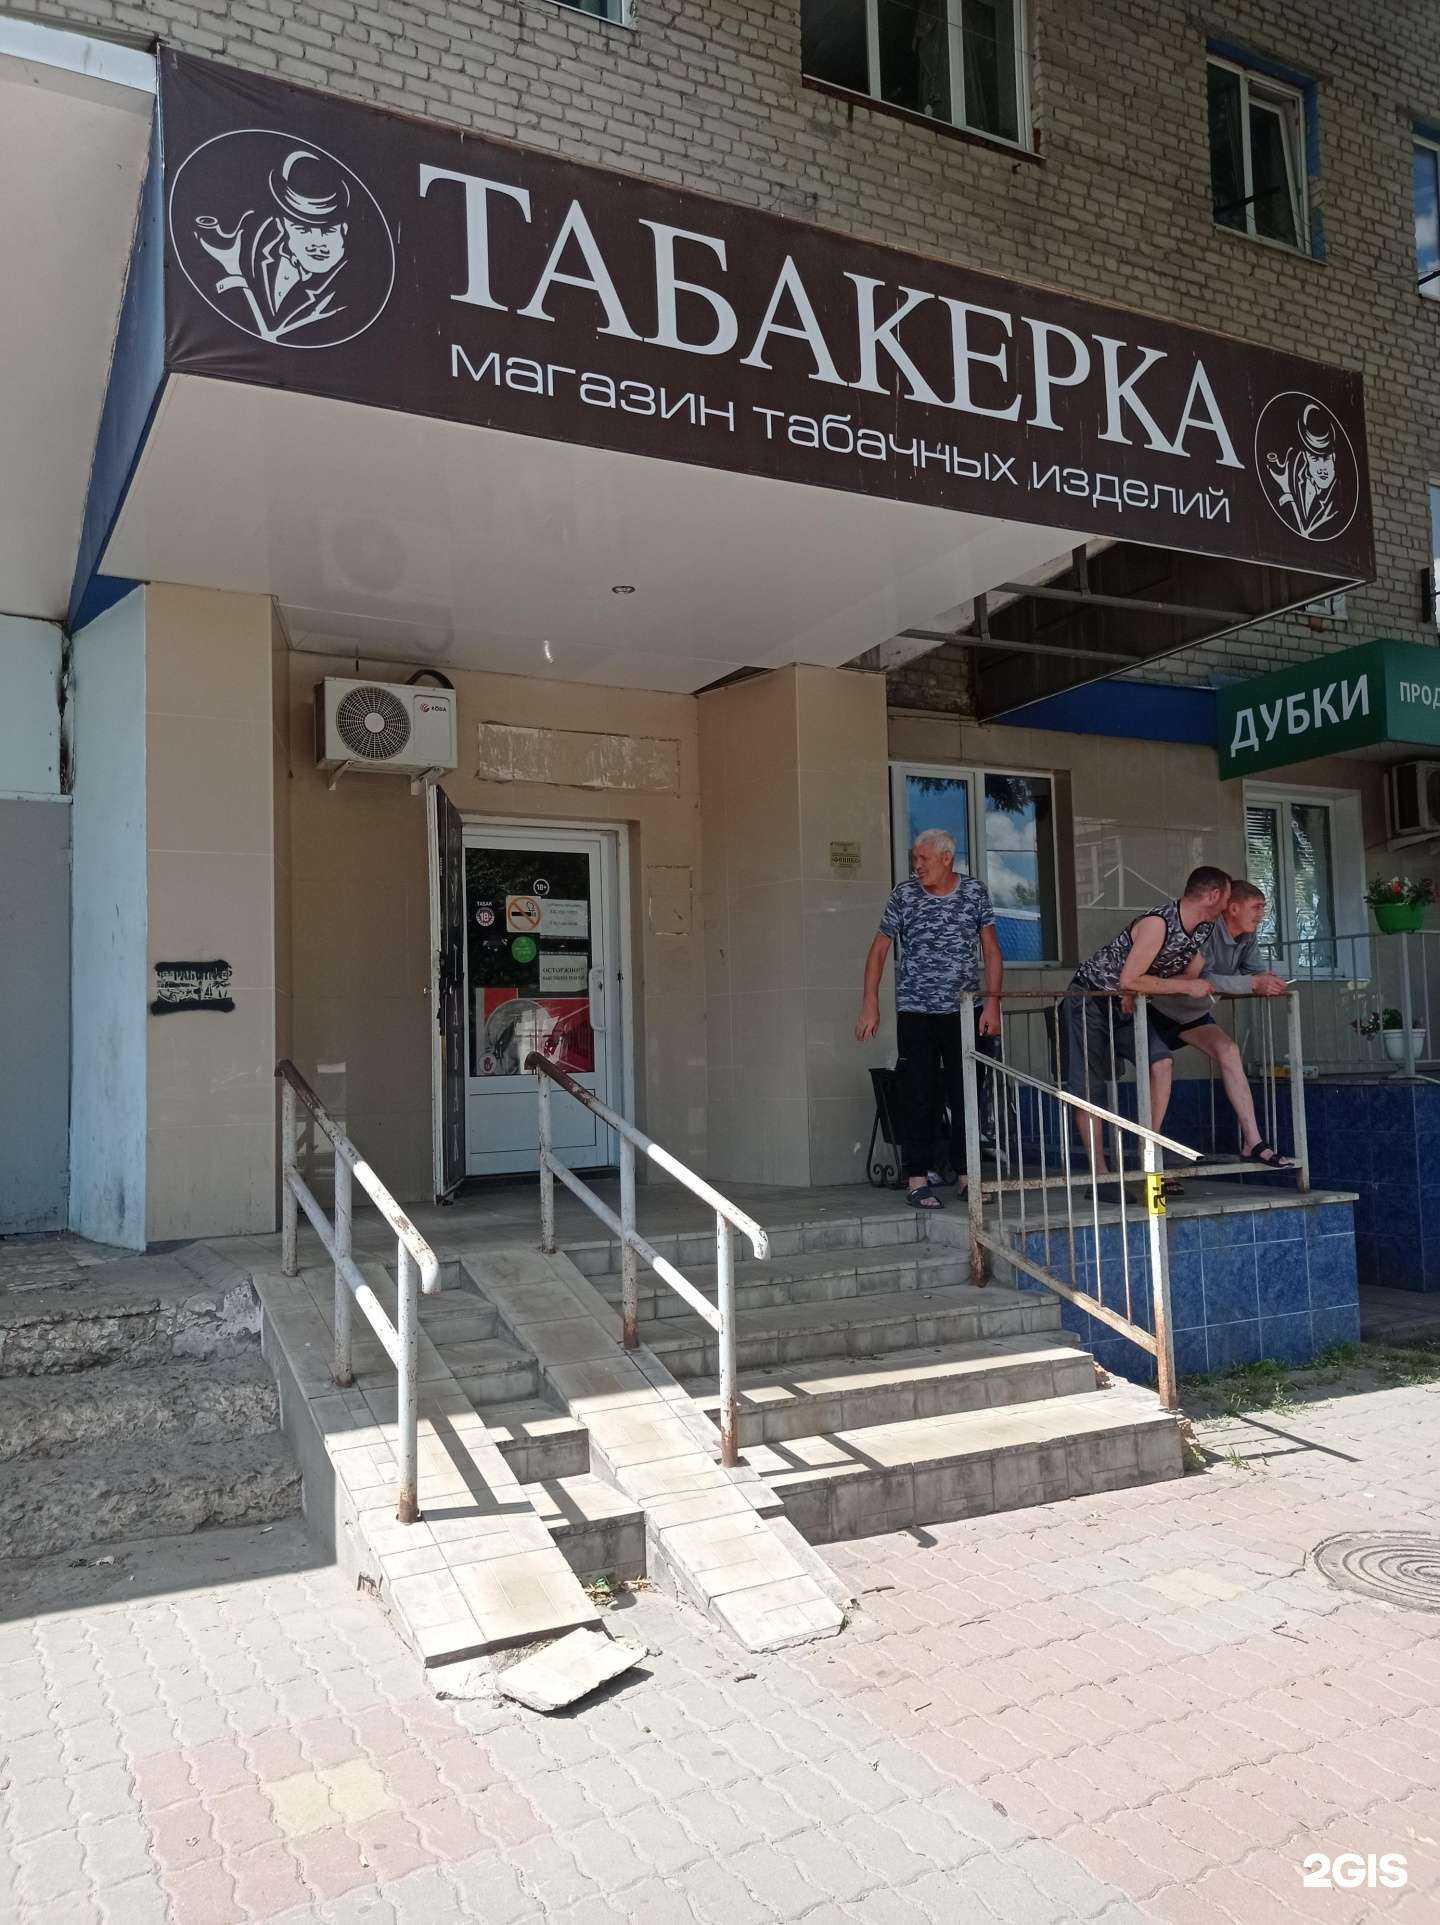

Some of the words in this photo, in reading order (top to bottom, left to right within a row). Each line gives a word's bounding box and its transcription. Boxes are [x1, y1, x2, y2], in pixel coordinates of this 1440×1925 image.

[418, 162, 1246, 470] ТАБАКЕРКА
[450, 342, 736, 435] магазин
[752, 405, 1018, 487] табачных
[1032, 460, 1231, 523] изделий
[1230, 673, 1370, 758] ДУБКИ
